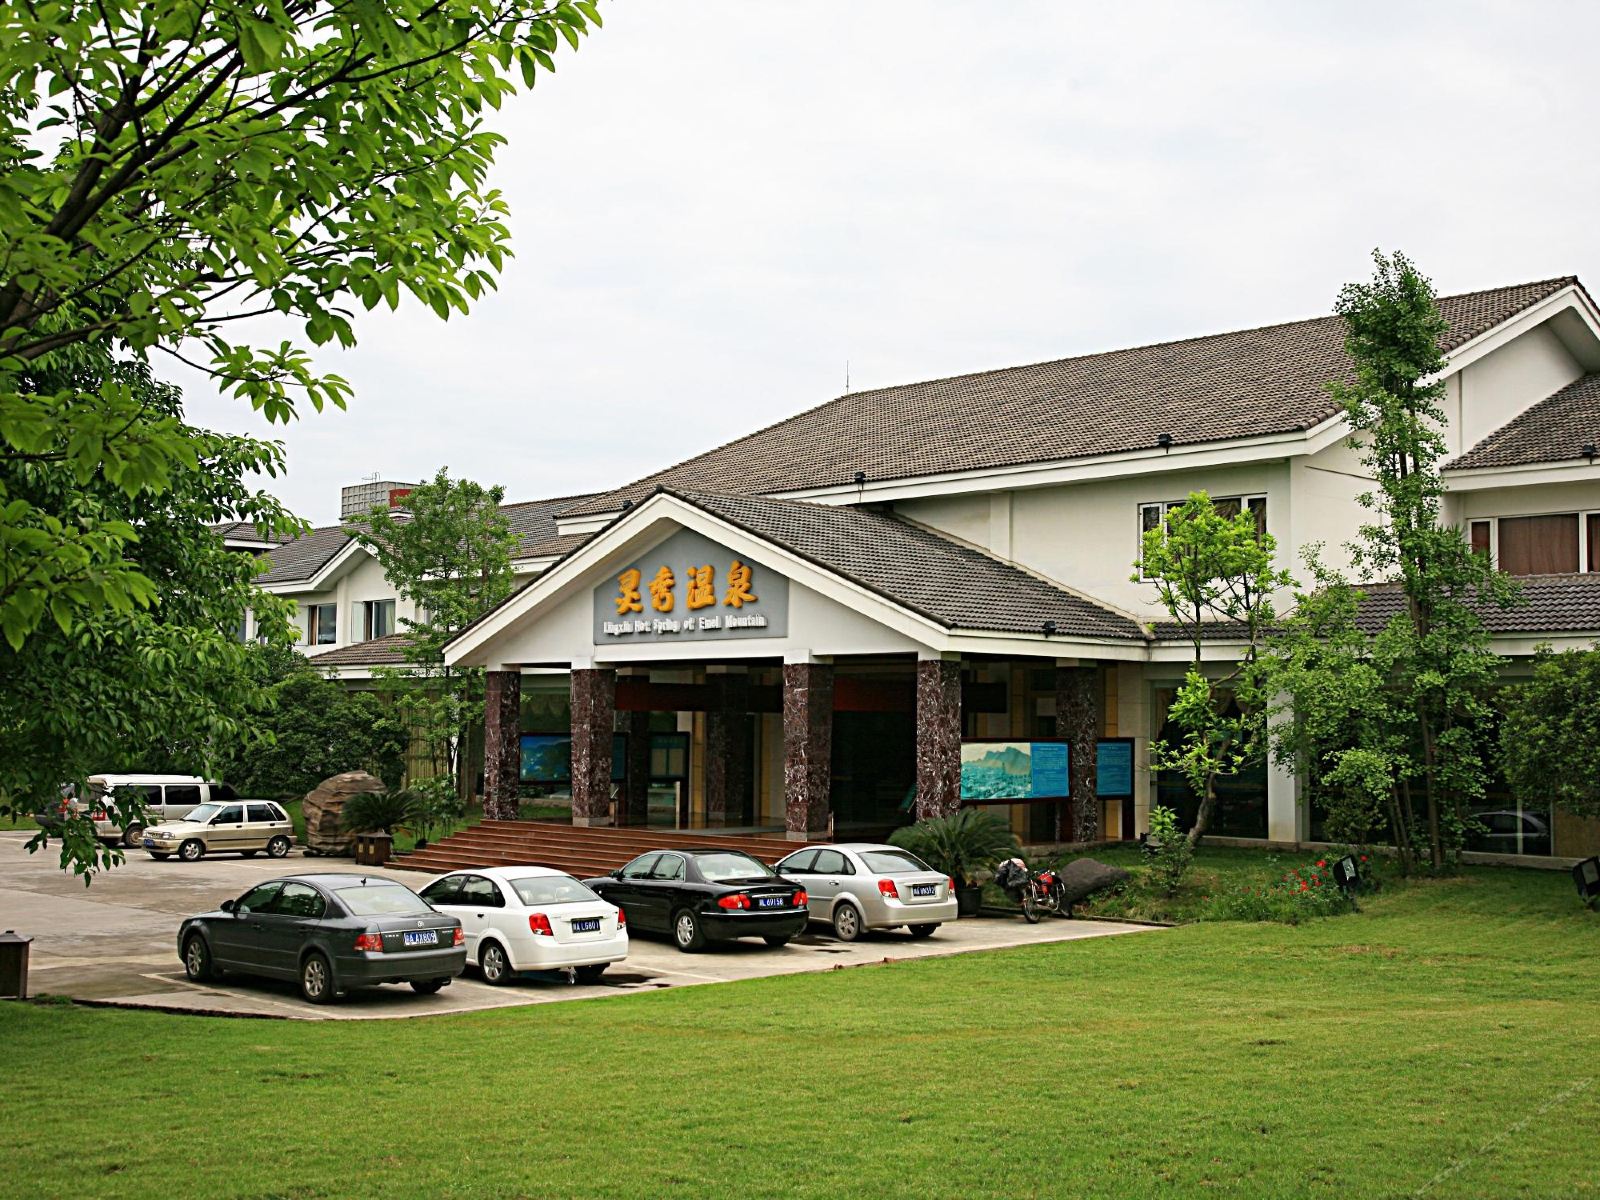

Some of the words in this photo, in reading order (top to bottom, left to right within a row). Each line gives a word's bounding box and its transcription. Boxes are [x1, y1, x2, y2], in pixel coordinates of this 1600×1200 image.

[614, 560, 758, 615] 灵秀温泉
[634, 620, 652, 633] Hot
[653, 618, 681, 634] Spring
[683, 617, 695, 631] of
[725, 613, 768, 629] Mountain
